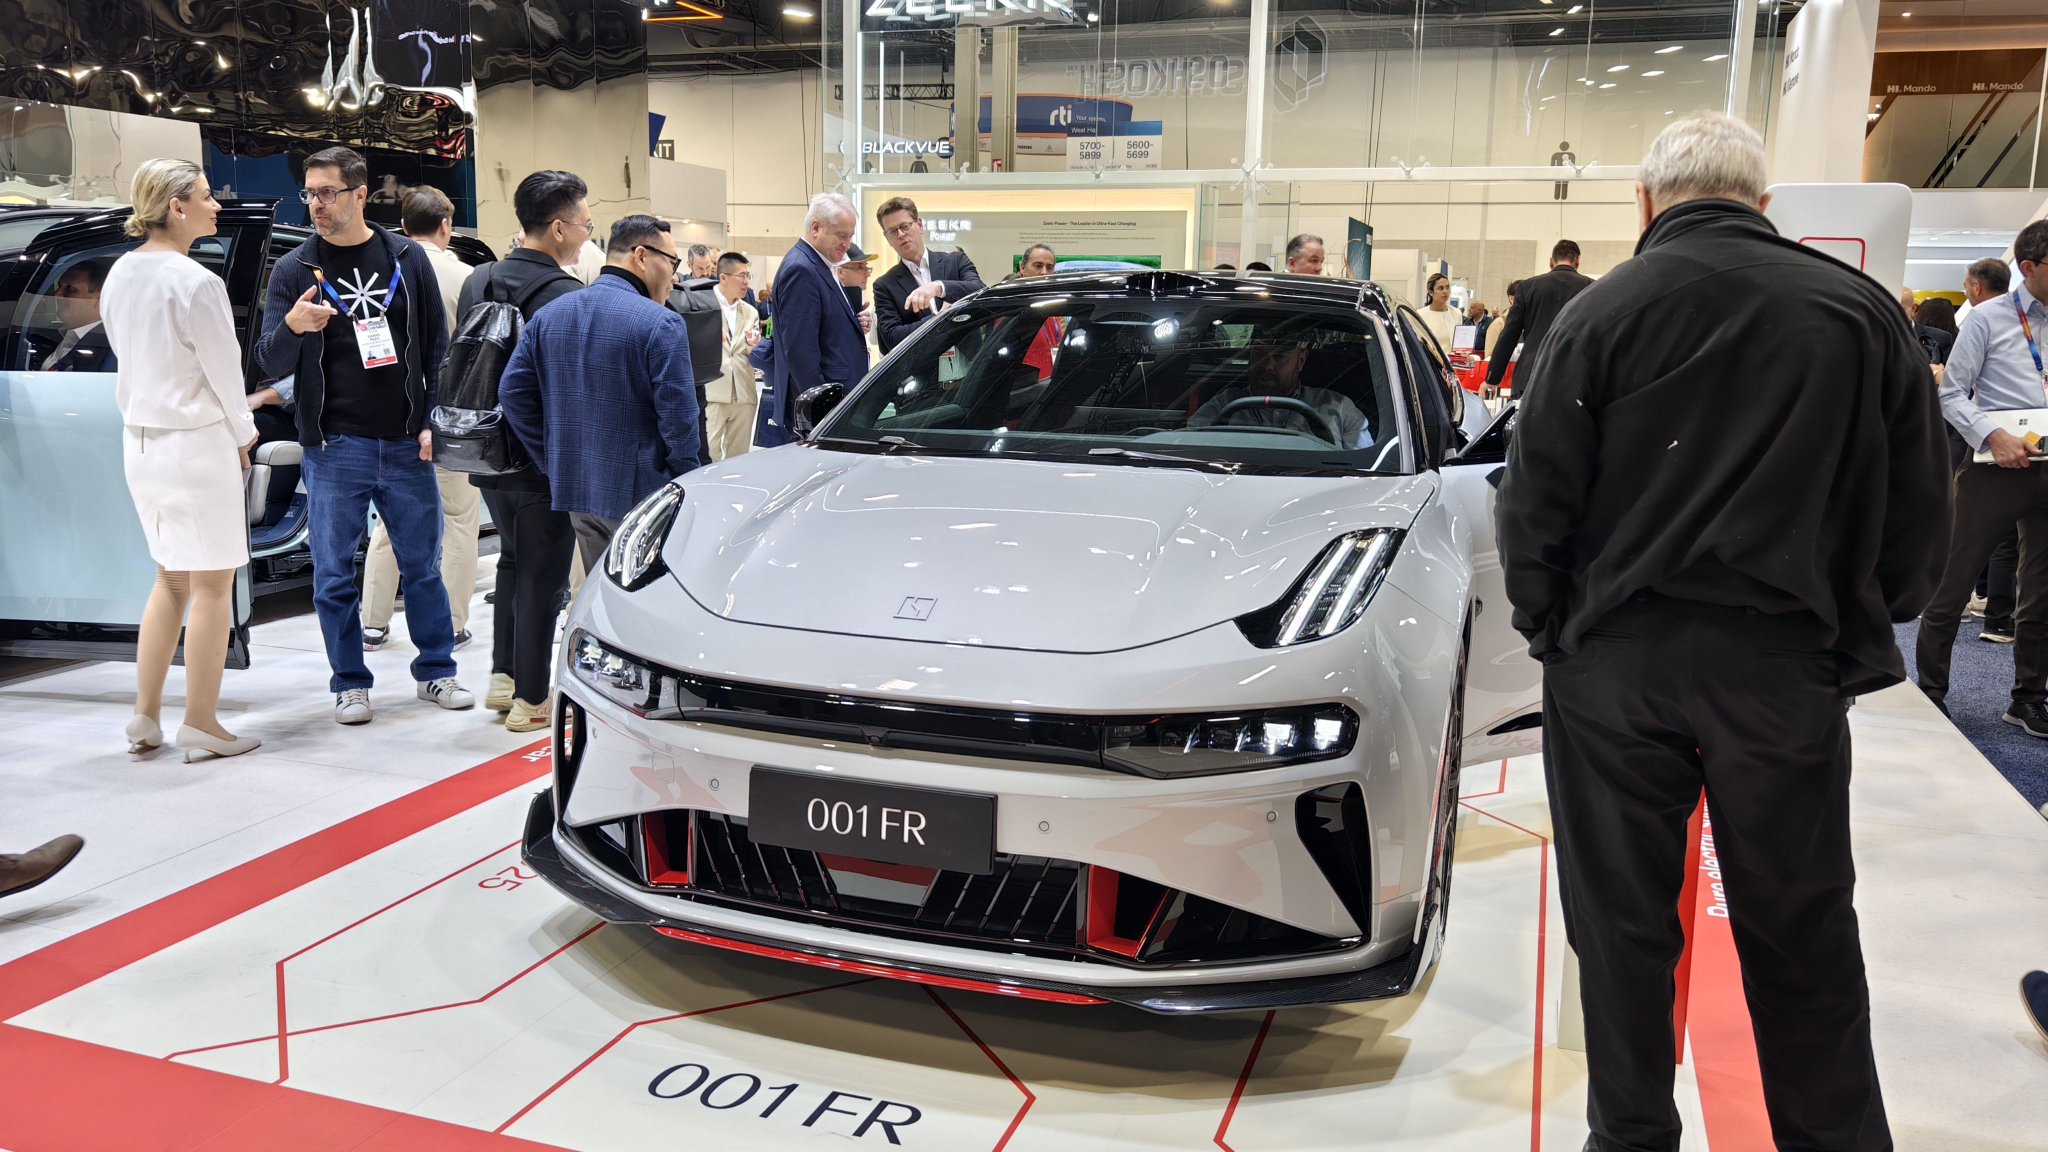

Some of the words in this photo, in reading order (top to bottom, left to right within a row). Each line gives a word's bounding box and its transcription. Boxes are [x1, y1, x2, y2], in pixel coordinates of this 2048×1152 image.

[1904, 84, 1936, 93] Mando
[1989, 82, 2024, 91] Mando
[1049, 103, 1073, 127] rti
[1071, 126, 1086, 134] West
[862, 141, 950, 154] BLACKVUE
[1079, 141, 1105, 150] 5700-
[1126, 140, 1154, 149] 5600-
[1079, 151, 1101, 159] 5899
[1126, 150, 1149, 159] 5699
[807, 798, 868, 838] 001
[881, 807, 926, 845] FR
[648, 1063, 799, 1119] 001
[802, 1091, 922, 1146] FR
